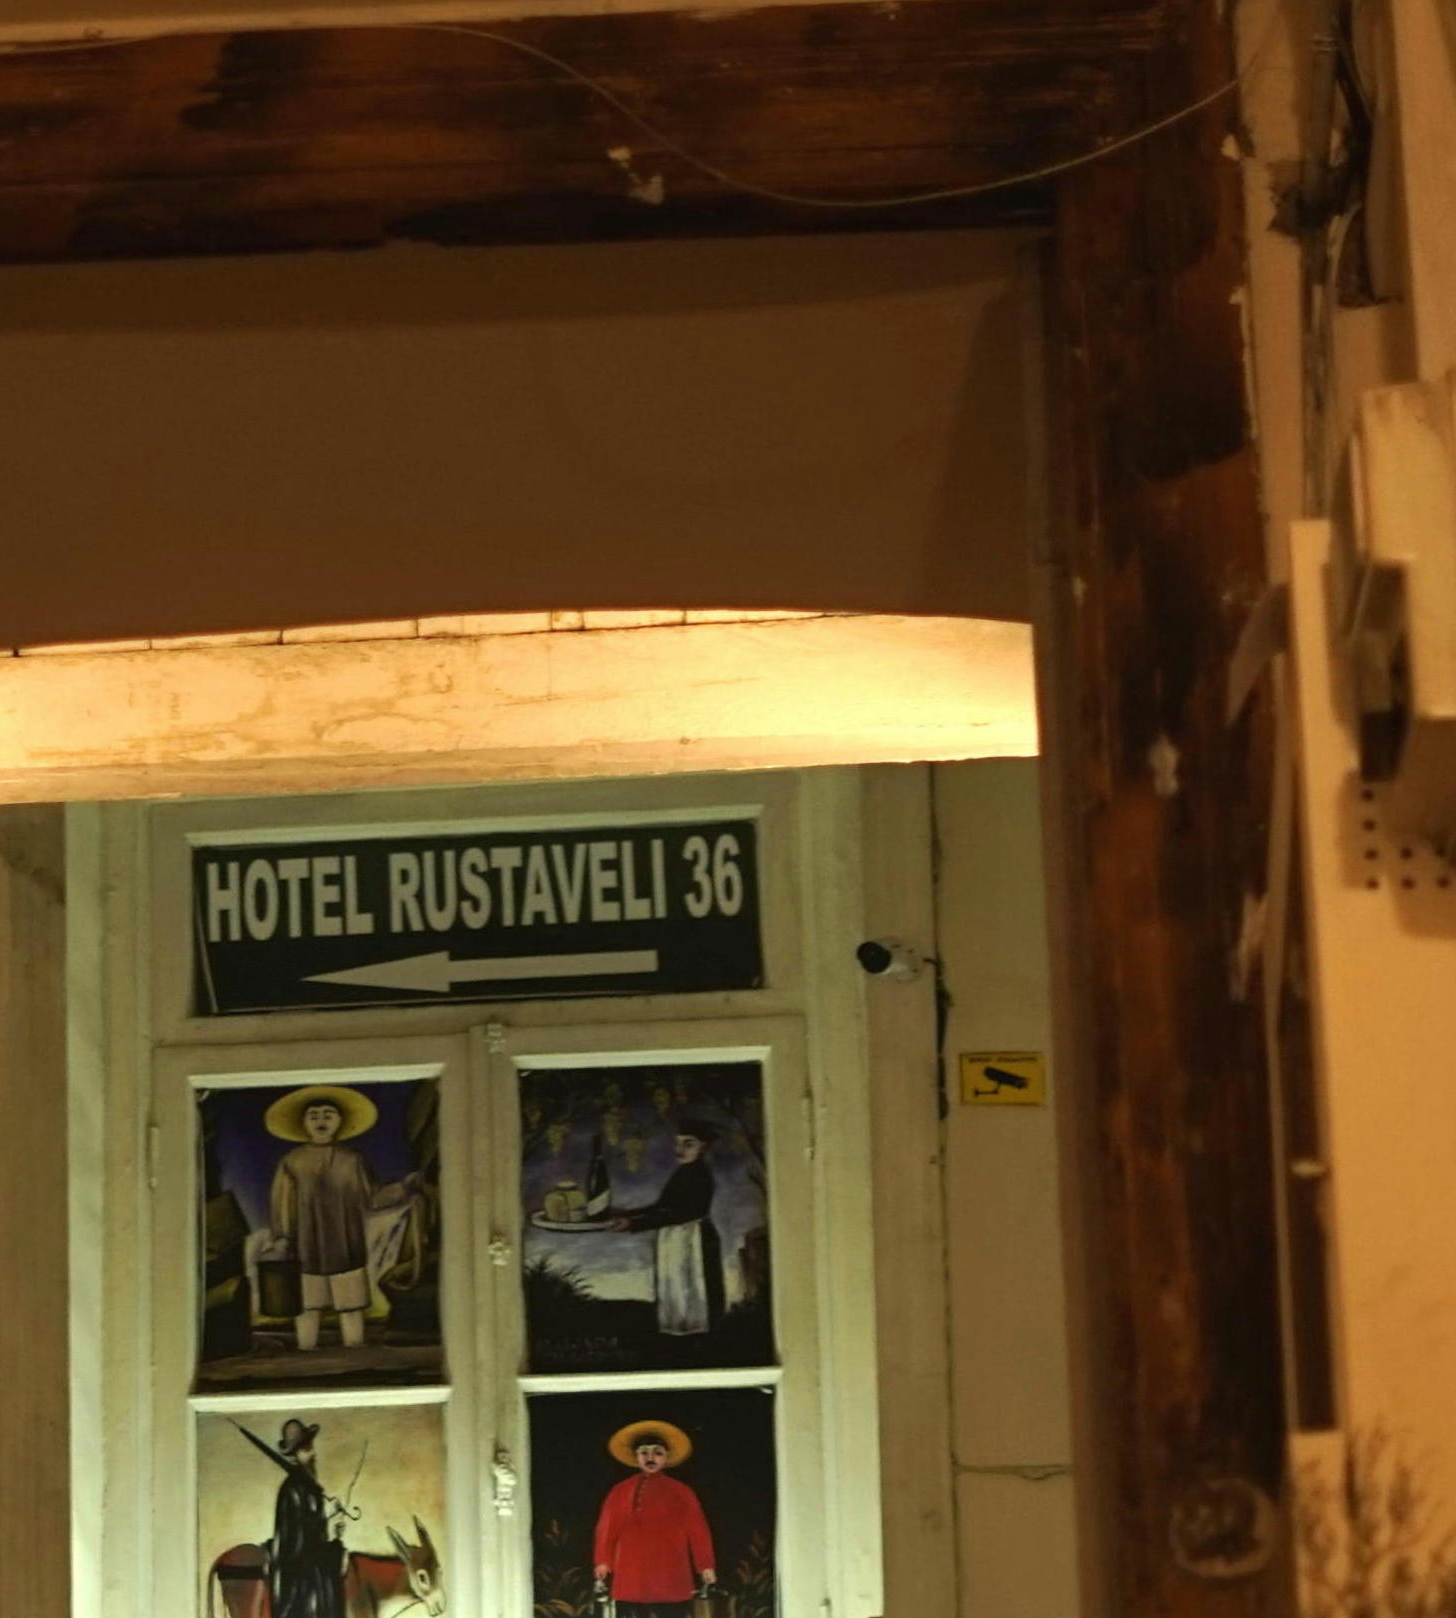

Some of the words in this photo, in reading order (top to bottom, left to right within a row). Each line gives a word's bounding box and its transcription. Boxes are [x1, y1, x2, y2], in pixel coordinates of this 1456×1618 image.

[206, 855, 372, 942] HOTEL
[389, 838, 666, 932] RUSTAVELI
[682, 835, 742, 917] 36
